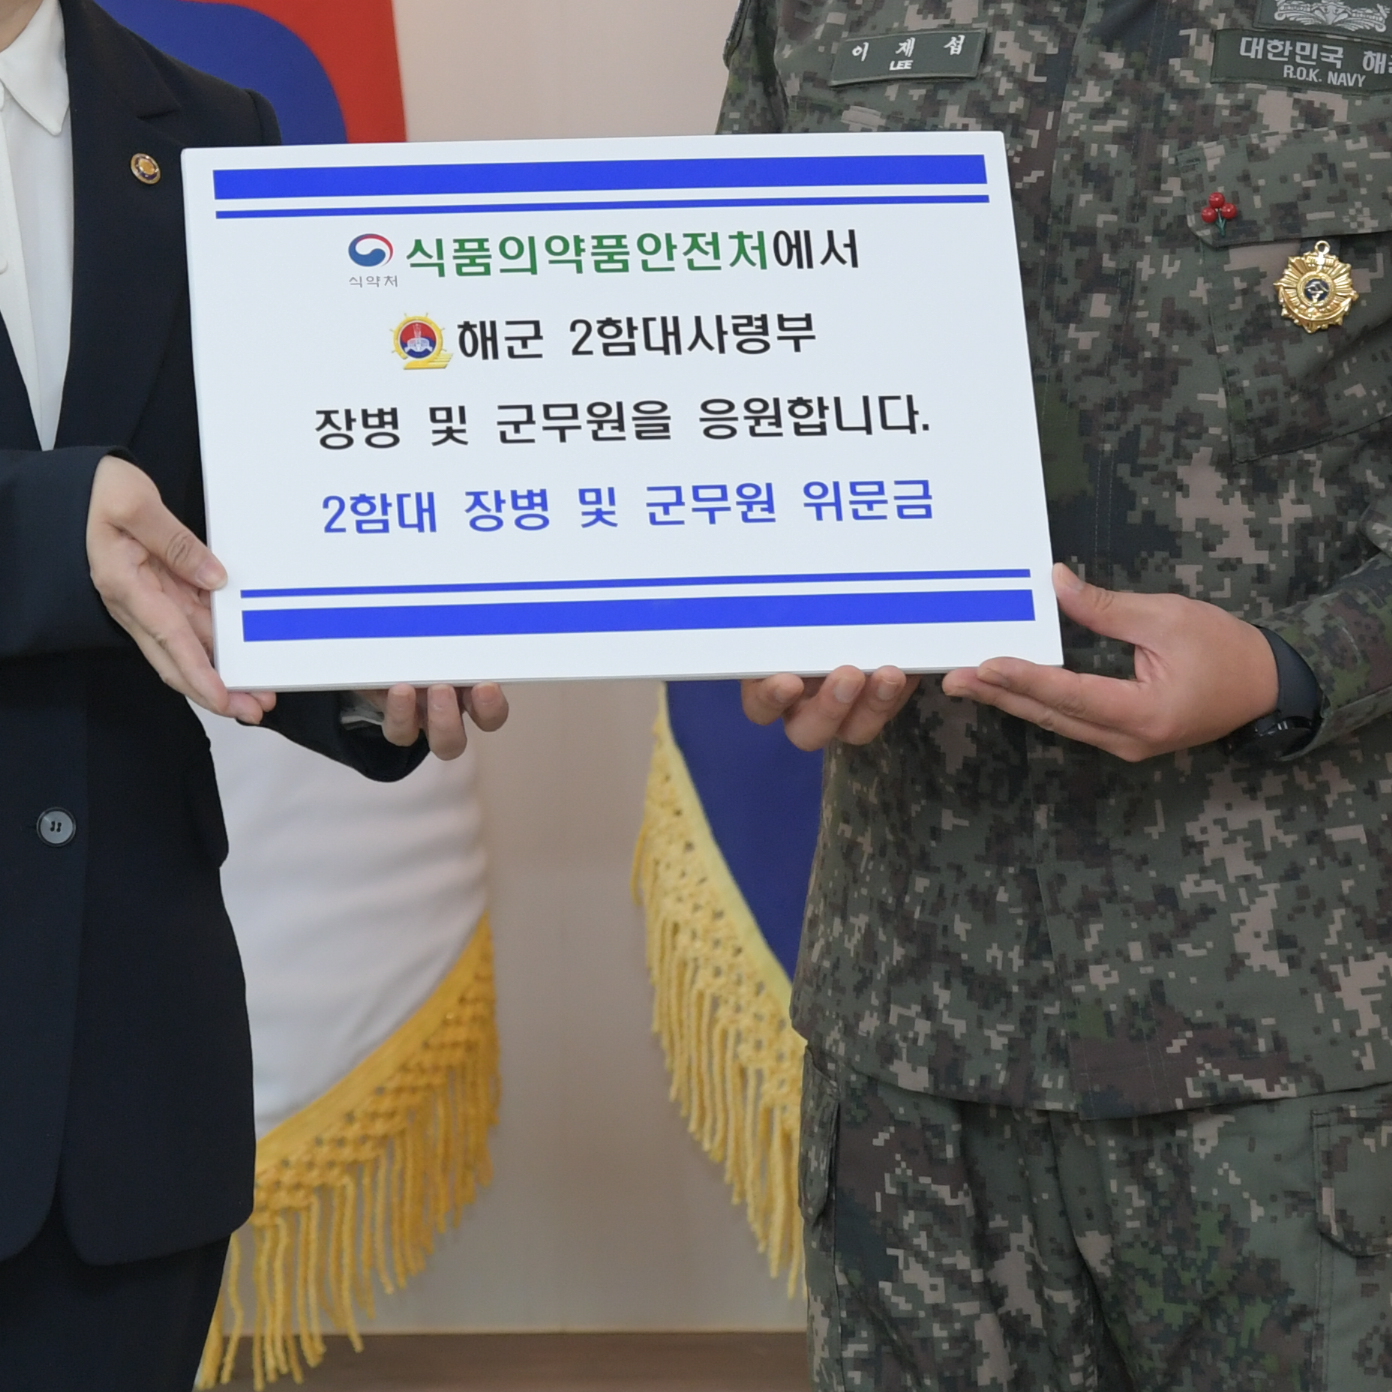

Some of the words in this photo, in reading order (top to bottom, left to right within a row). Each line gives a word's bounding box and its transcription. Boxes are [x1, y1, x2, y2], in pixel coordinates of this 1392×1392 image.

[889, 59, 914, 71] LEE
[1239, 36, 1344, 70] 대한민국
[1283, 64, 1322, 83] R.O.K.
[1327, 70, 1367, 88] NAVY
[406, 229, 859, 278] 식품의약품안전처에서
[349, 275, 398, 288] 식약처
[457, 319, 544, 361] 해군
[569, 312, 817, 357] 2함대사령부
[315, 406, 401, 451] 장병
[428, 405, 469, 447] 및
[496, 400, 672, 444] 군무원을
[698, 394, 930, 440] 응원합니다.
[322, 491, 437, 535] 2함대
[464, 488, 550, 533] 장병
[578, 486, 618, 529] 및
[645, 482, 777, 526] 군무원
[803, 479, 933, 522] 위문금
